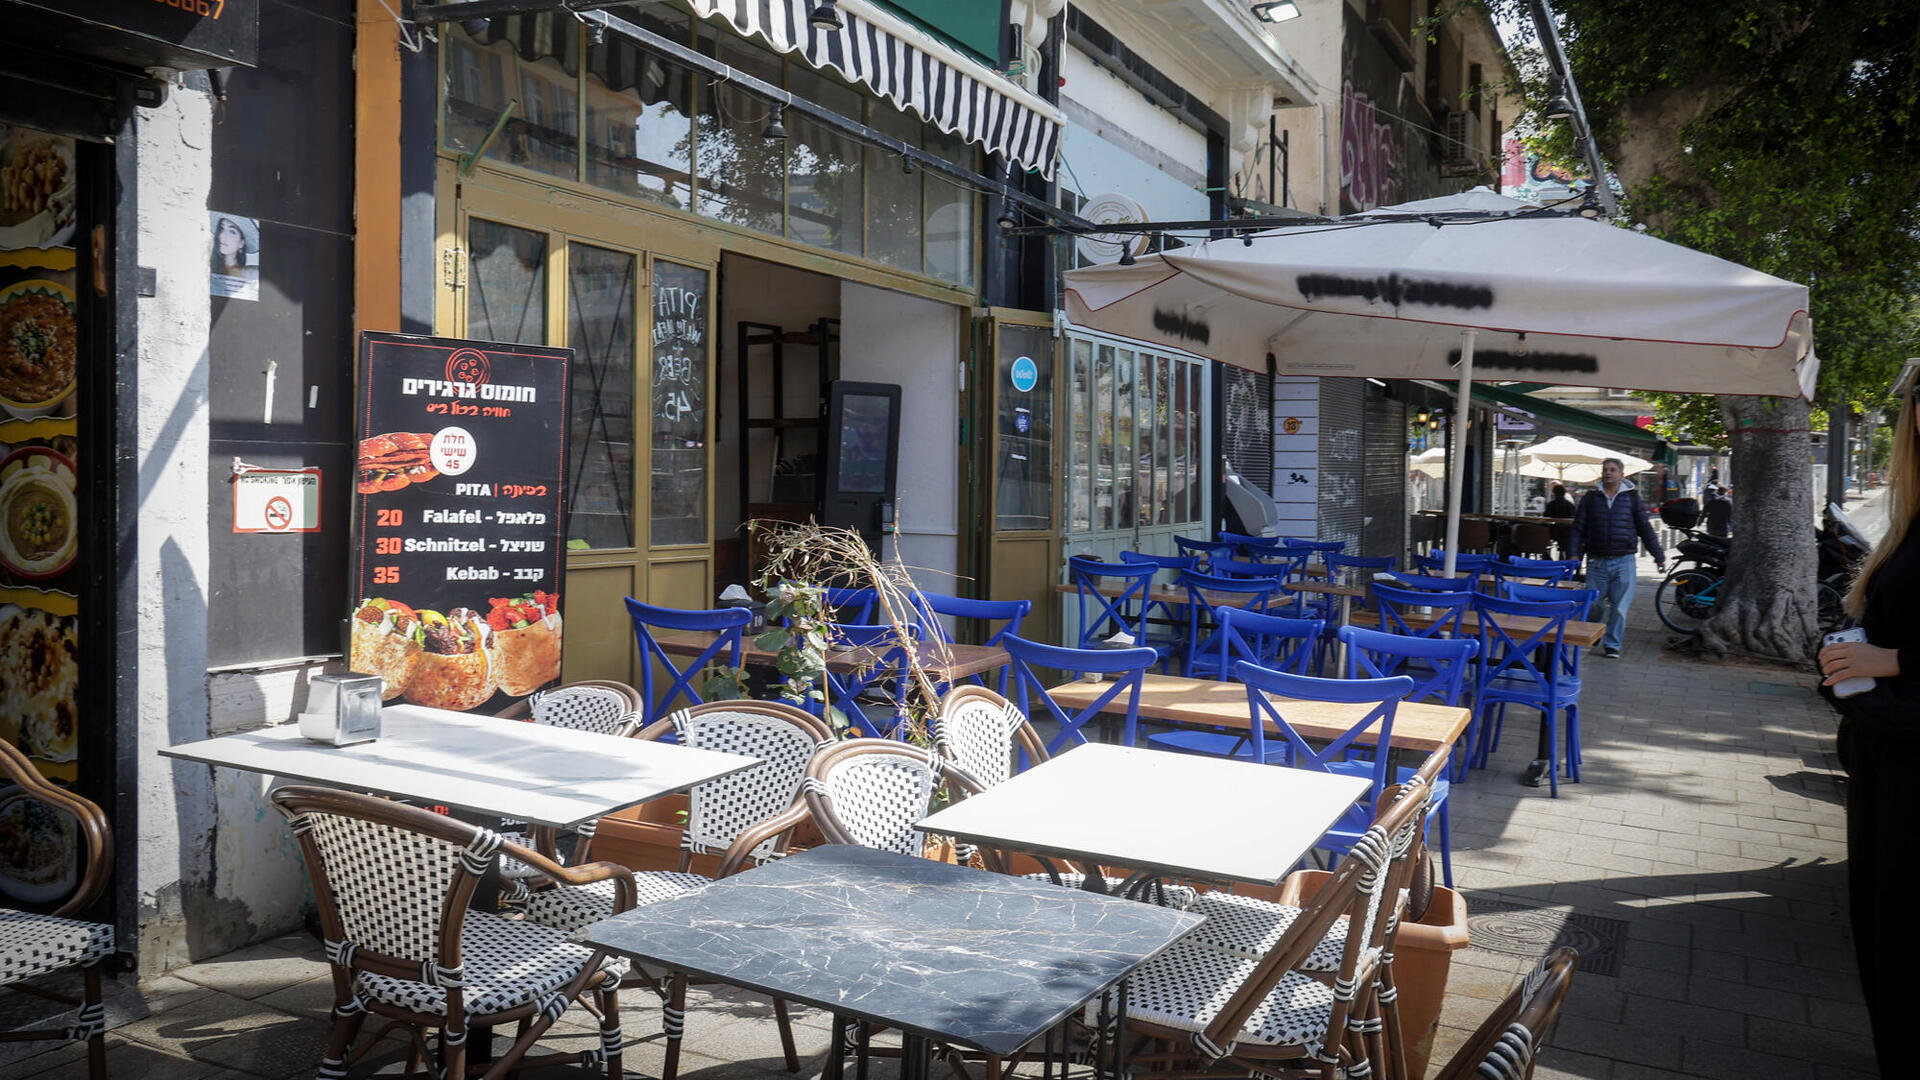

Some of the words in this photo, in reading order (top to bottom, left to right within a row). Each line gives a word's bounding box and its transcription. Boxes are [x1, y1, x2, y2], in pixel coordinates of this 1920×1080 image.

[402, 378, 477, 399] גרגירים
[480, 383, 536, 403] חומוס
[444, 434, 465, 445] חלת
[440, 447, 467, 457] שישי
[445, 459, 460, 469] 45
[455, 483, 492, 496] PITA
[376, 509, 403, 527] 20
[423, 509, 482, 524] Falafel
[496, 511, 546, 525] פלאפל
[375, 537, 402, 555] 30
[404, 537, 486, 552] Schnitzel
[500, 539, 545, 552] שניצל
[373, 566, 400, 584] 35
[446, 566, 499, 580] Kebab
[513, 568, 544, 582] קבב
[754, 615, 763, 627] 10
